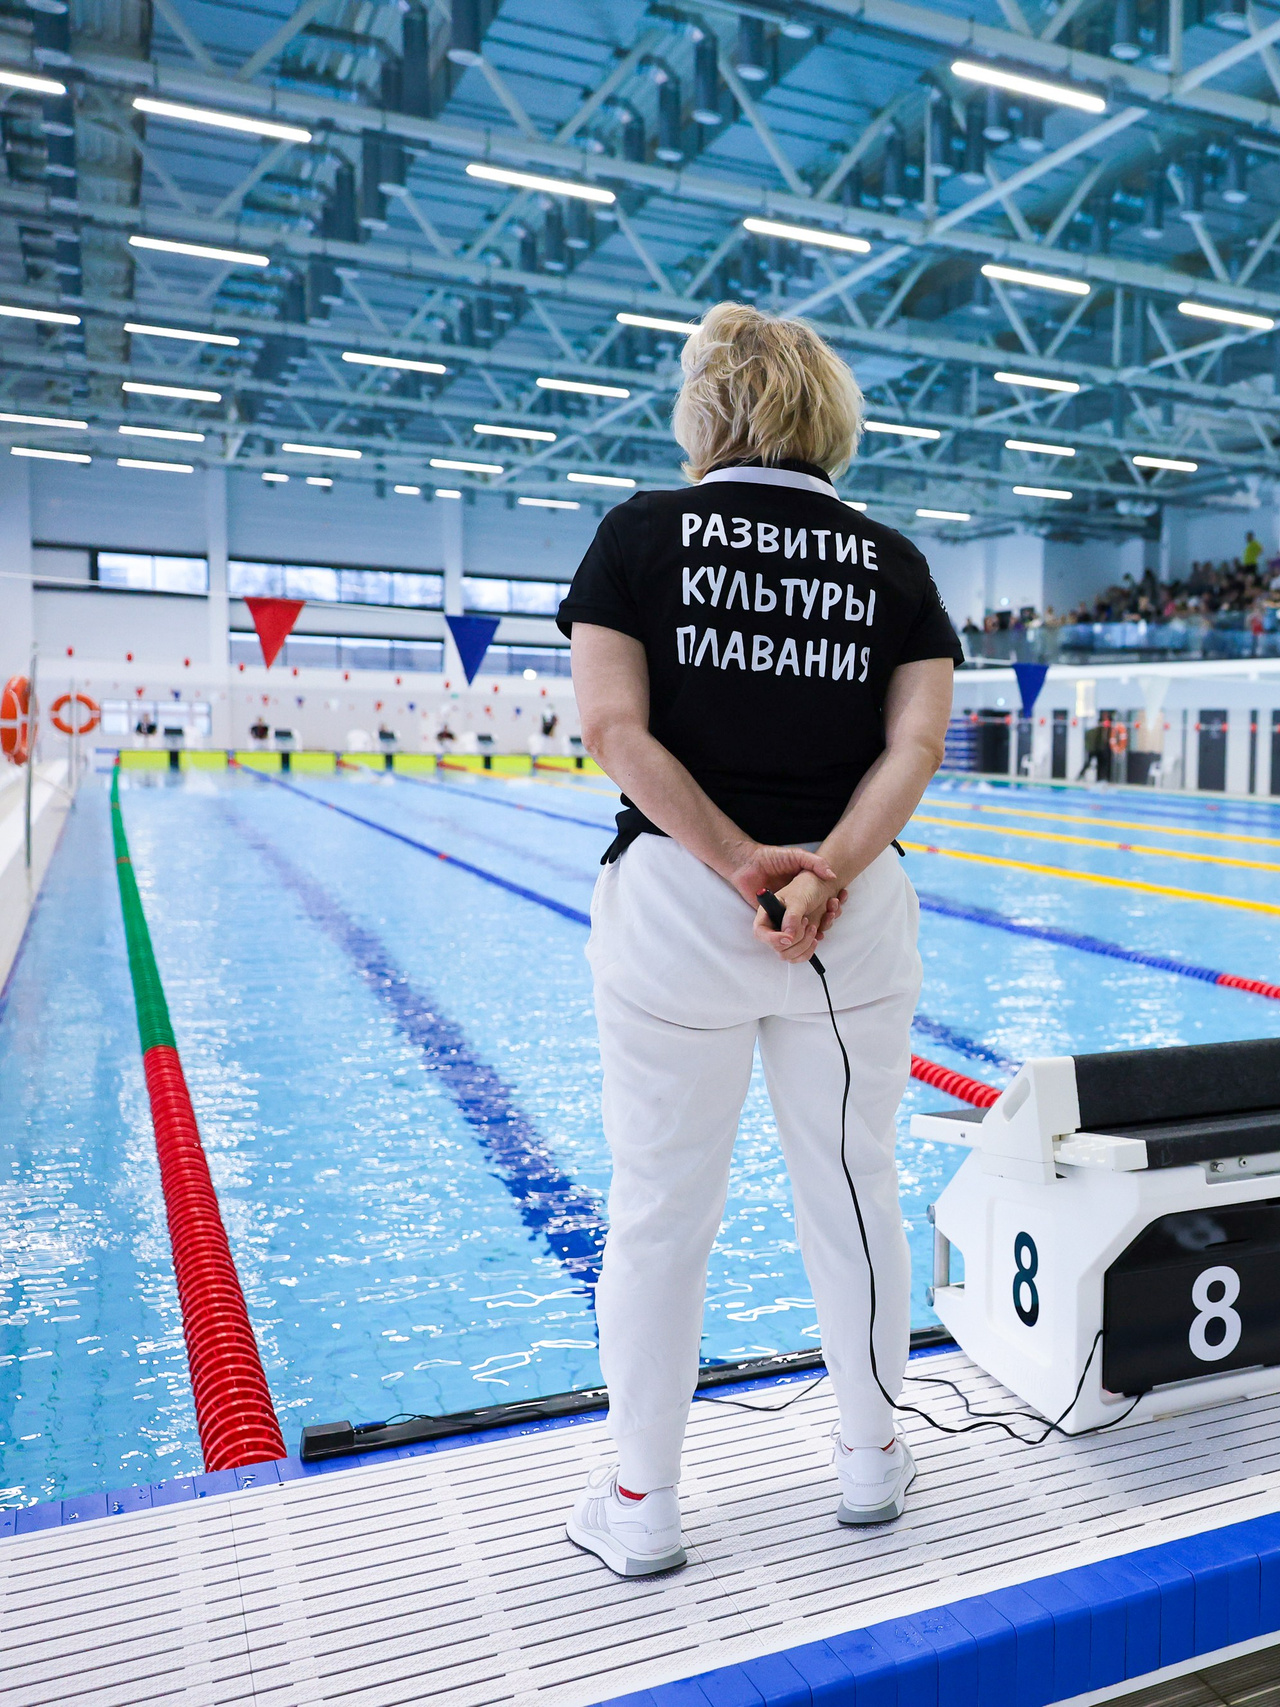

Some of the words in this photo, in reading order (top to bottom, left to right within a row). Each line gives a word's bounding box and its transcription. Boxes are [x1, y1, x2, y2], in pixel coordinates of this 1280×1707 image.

[681, 513, 879, 571] РАЗВИТИЕ
[682, 565, 877, 627] КУЛЬТУРЫ
[676, 625, 871, 683] ПЛАВАНИЯ
[1012, 1231, 1040, 1328] 8
[1188, 1265, 1242, 1362] 8
